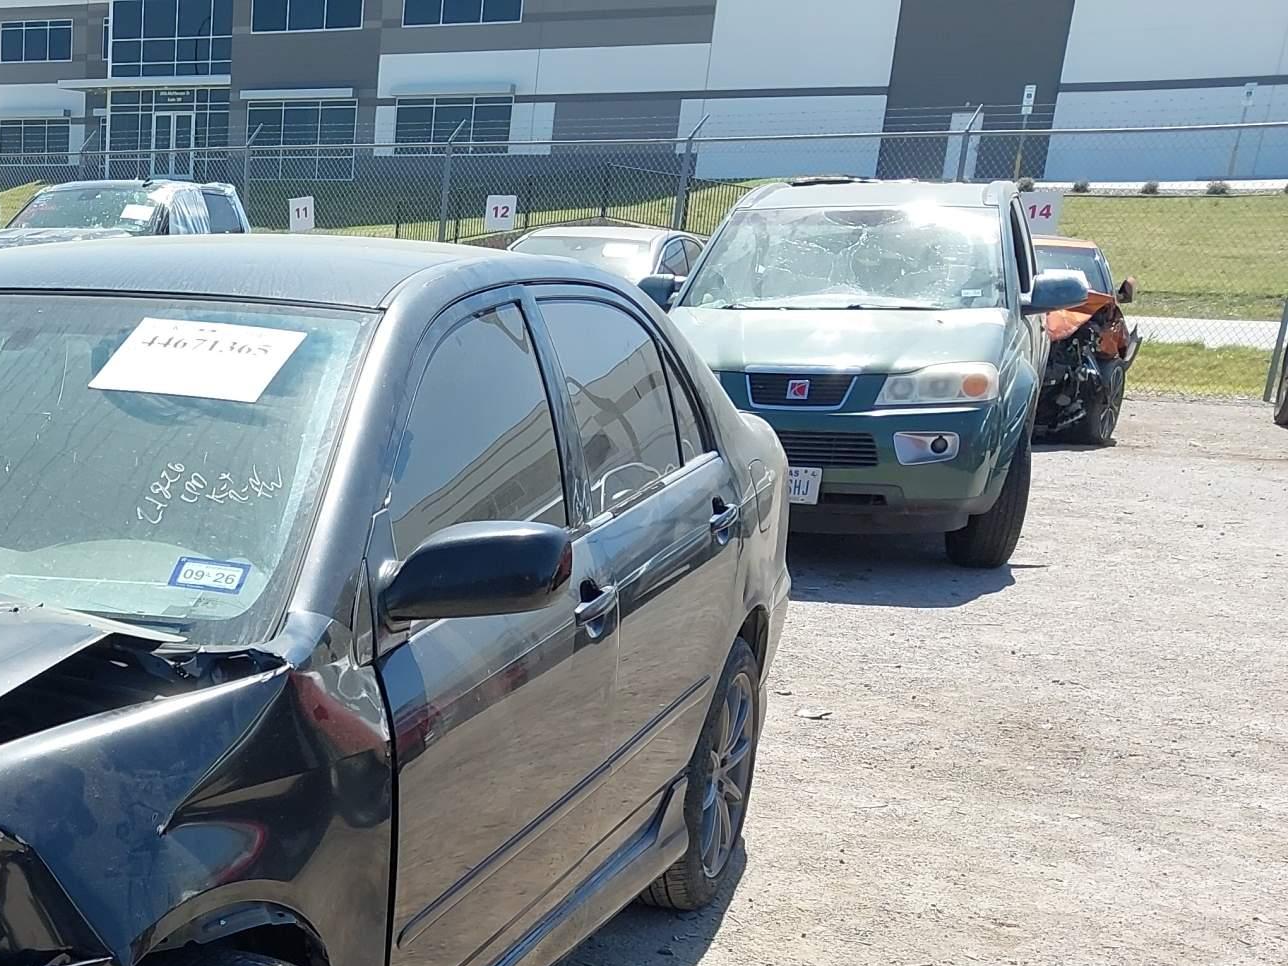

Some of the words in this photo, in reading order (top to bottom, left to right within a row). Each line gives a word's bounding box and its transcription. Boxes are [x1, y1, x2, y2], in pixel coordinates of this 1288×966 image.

[295, 206, 309, 220] 11
[492, 205, 510, 219] 12
[1028, 204, 1052, 219] 14
